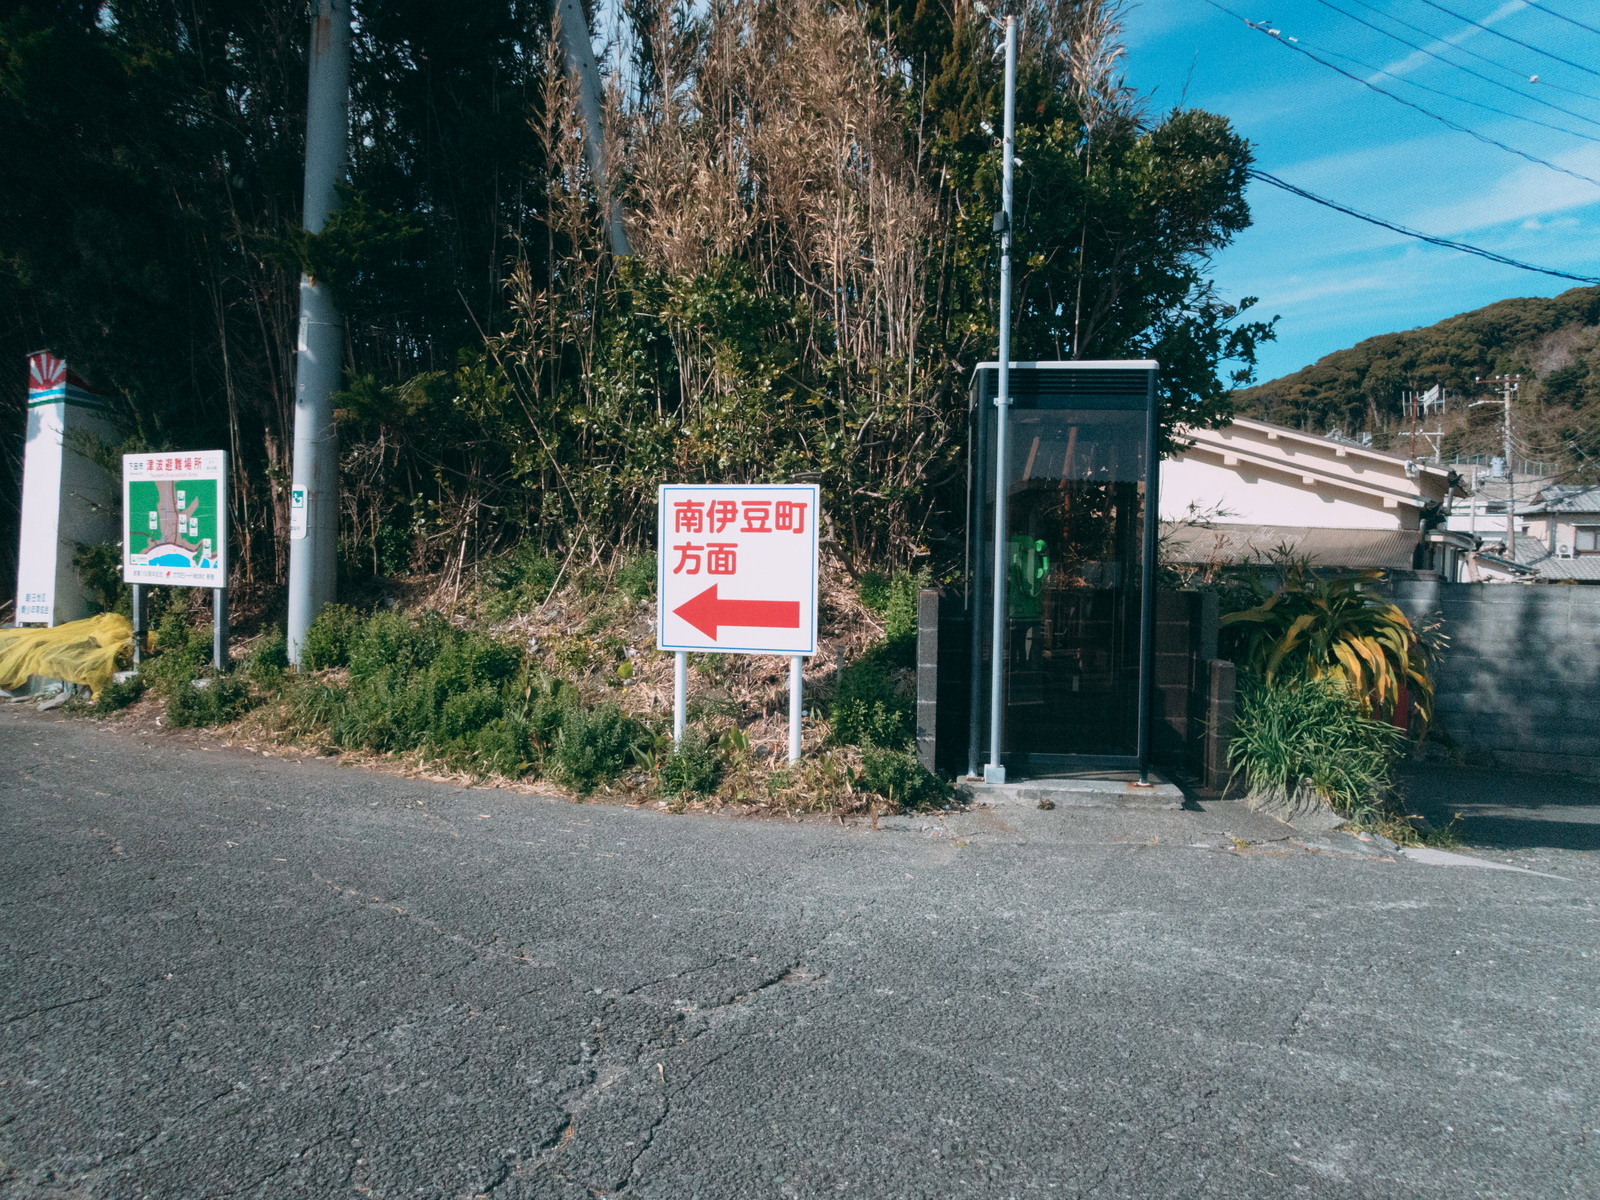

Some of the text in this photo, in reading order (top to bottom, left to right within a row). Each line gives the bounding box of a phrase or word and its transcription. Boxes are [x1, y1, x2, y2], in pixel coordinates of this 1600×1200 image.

[673, 499, 807, 534] 南伊豆町
[673, 541, 738, 575] 方面
